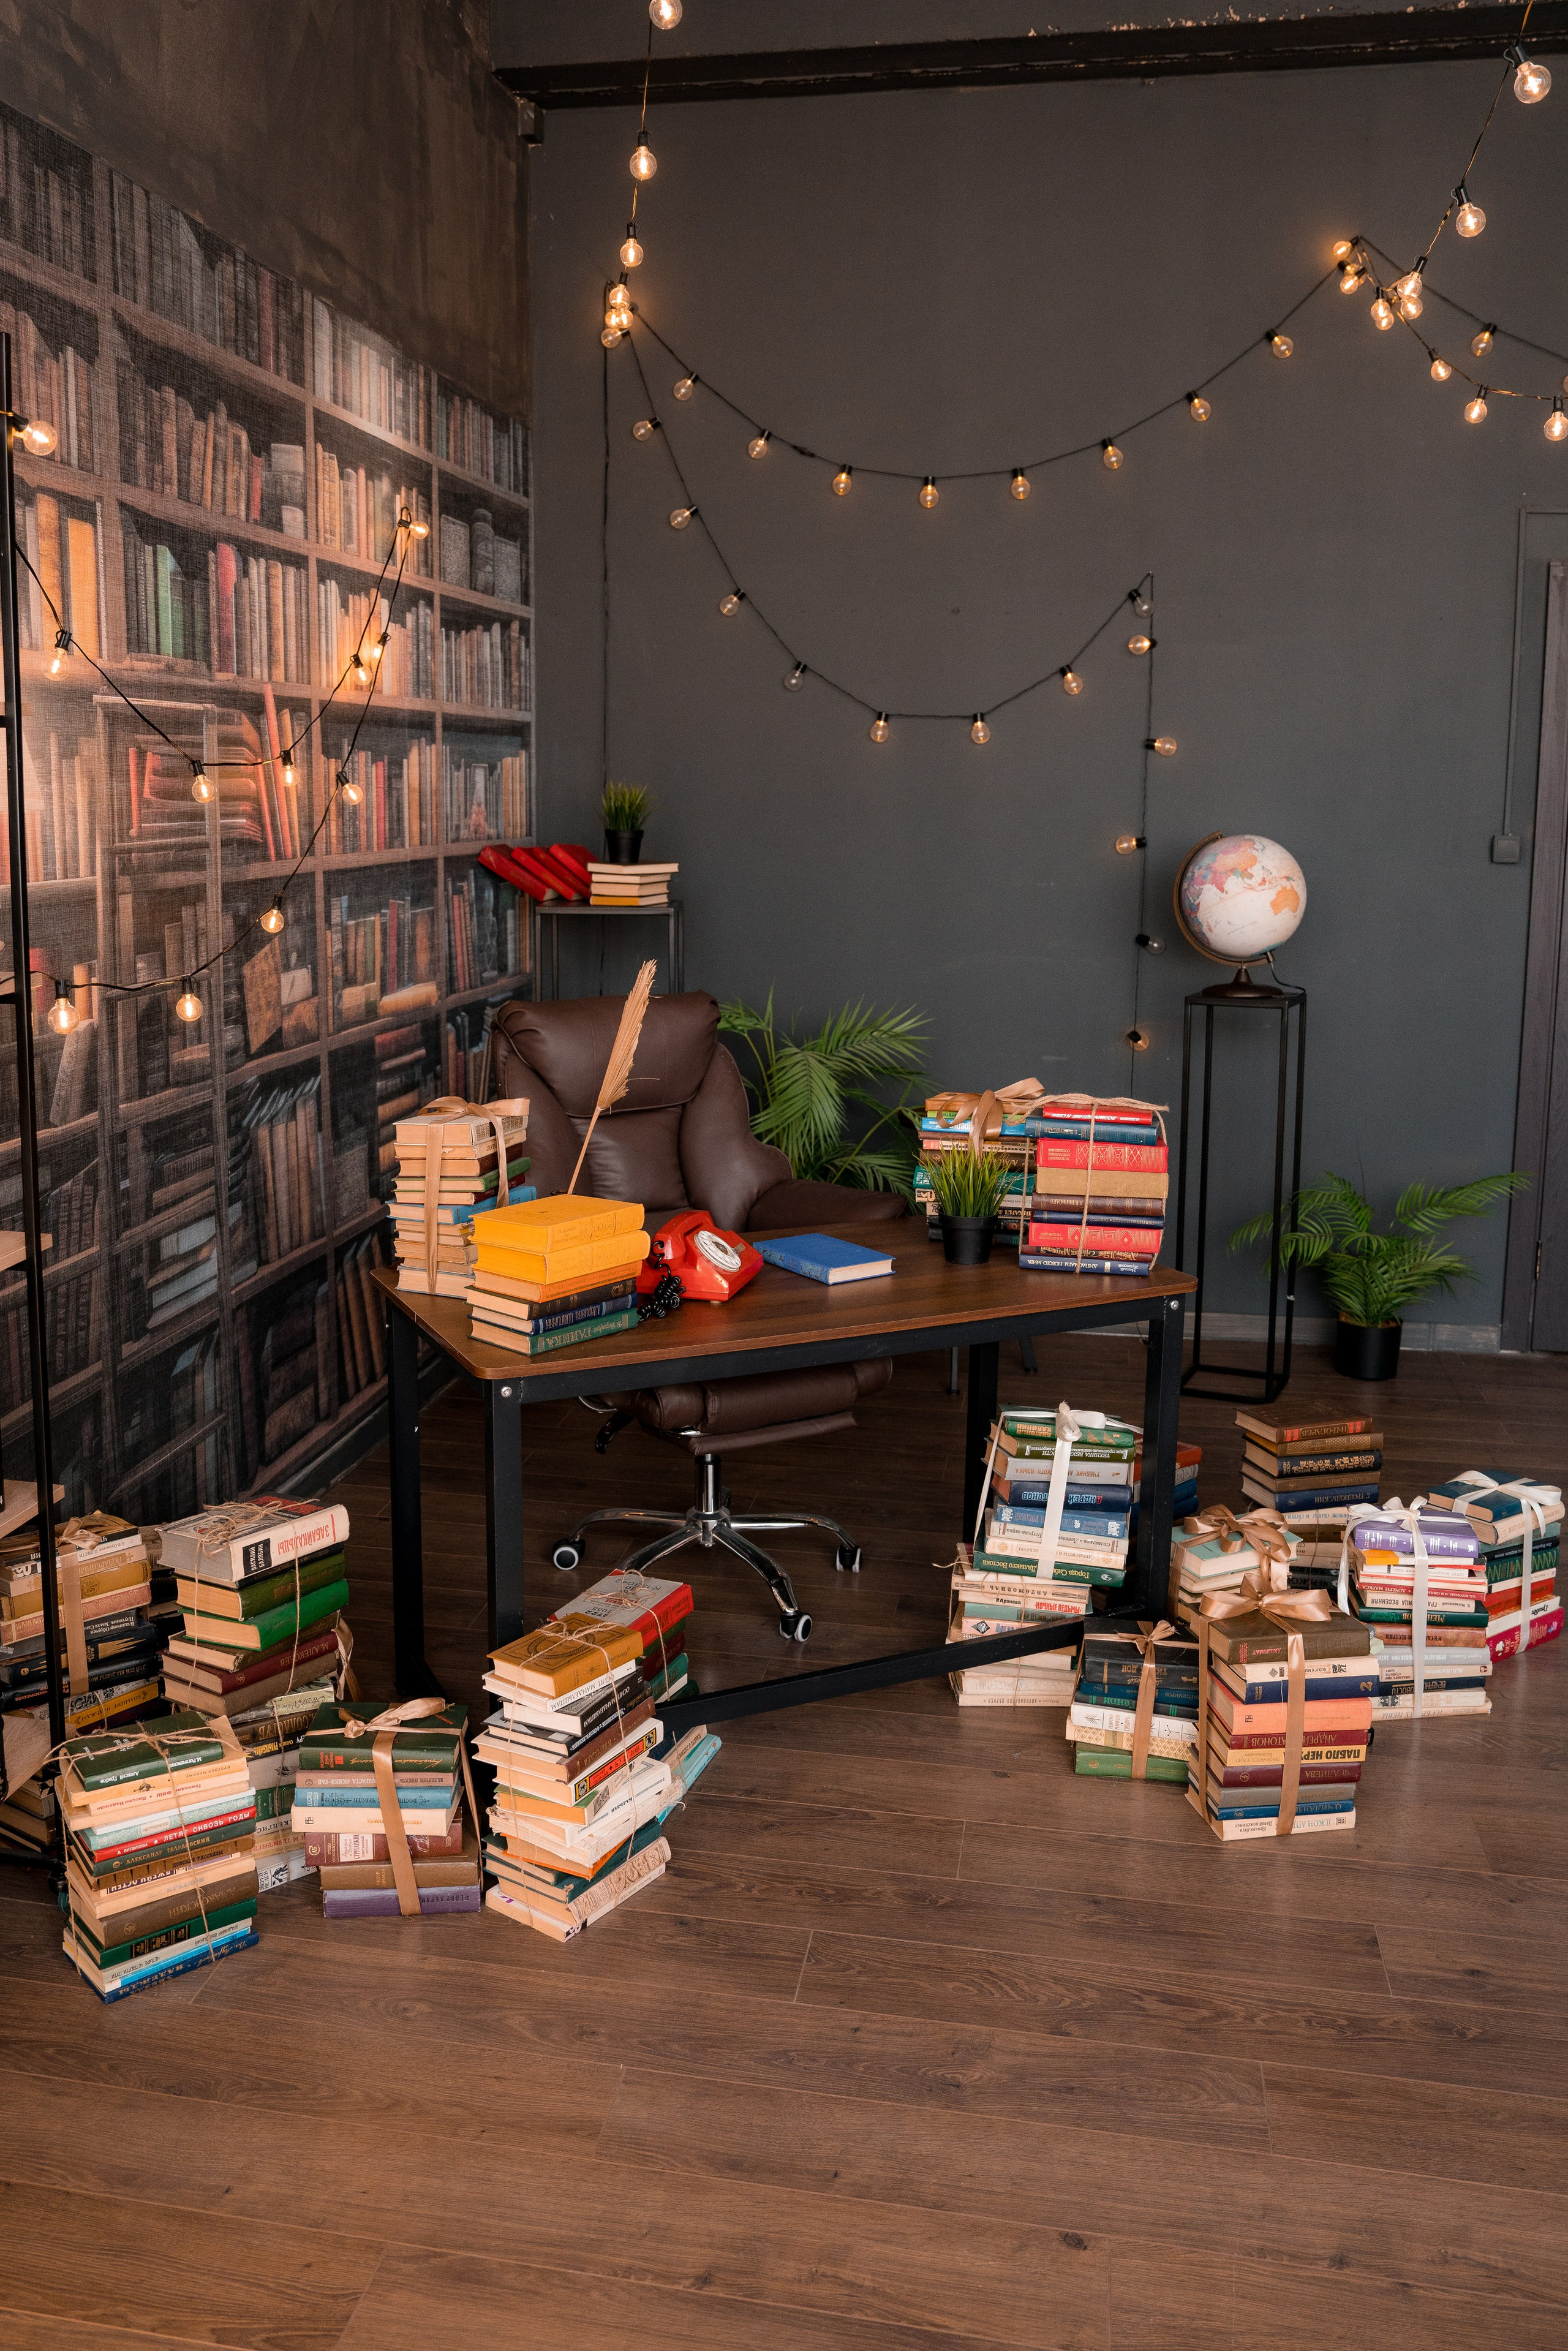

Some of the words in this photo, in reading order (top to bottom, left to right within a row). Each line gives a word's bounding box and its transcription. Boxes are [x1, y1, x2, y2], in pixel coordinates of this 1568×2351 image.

[546, 1327, 591, 1348] ГЛИНКА
[1327, 1476, 1364, 1485] АДАМОВИЧ
[1068, 1495, 1102, 1504] АНДРЕЙ
[1314, 1494, 1365, 1503] ТРОЕПОЛЬСКИЙ
[1006, 1528, 1042, 1538] Багрова-внука
[277, 1525, 330, 1555] ЗАБАЙКАЛЬЦЫ
[79, 1549, 98, 1558] ПОВЕСТИ
[982, 1560, 1008, 1570] Востока
[1009, 1563, 1037, 1572] Дальнего
[1068, 1569, 1090, 1579] Города
[989, 1585, 1047, 1596] АВТОМОБИЛЬ
[90, 1625, 110, 1635] Обручев
[110, 1621, 134, 1632] Владимир
[320, 1642, 328, 1650] М.
[280, 1647, 319, 1666] АЛЕКСЕЕВ
[598, 1674, 615, 1687] ОСИП
[1360, 1681, 1372, 1691] 2
[551, 1683, 595, 1710] МАНДЕЛЬШТАМ
[617, 1686, 630, 1700] ОСИП
[113, 1694, 141, 1710] БОЛЬШИЕ
[1102, 1697, 1136, 1708] Генри
[81, 1705, 111, 1721] НАДЕЖДЫ
[583, 1697, 616, 1727] МАНДЕЛЬШТАМ
[258, 1715, 309, 1741] СОЛЛОГУБ
[1302, 1733, 1336, 1745] АНДРЕЙ
[584, 1739, 611, 1767] В.ВЕРЕСАЕВ
[1325, 1749, 1360, 1760] ПАБЛО
[205, 1765, 231, 1773] ПРОСПЕР
[119, 1770, 140, 1780] Алексей
[176, 1783, 201, 1792] Геннадий
[97, 1800, 125, 1810] Надежде
[126, 1794, 146, 1805] Письмо
[1307, 1819, 1331, 1827] ДЖОН
[124, 1843, 148, 1853] ЛИТВИНОВА
[164, 1829, 188, 1841] ЛЕТЯТ
[193, 1819, 224, 1832] СКВОЗЬ
[228, 1811, 250, 1822] ГОДЫ
[126, 1849, 164, 1865] АЛЕКСАНДР
[167, 1836, 210, 1853] ТВАРДОВСКИЙ
[173, 1857, 195, 1868] ДОНСКИЕ
[197, 1850, 223, 1861] РАССКАЗЫ
[264, 1881, 268, 1890] НЕ
[168, 1890, 226, 1919] ЧАКОВСКИЙ
[217, 1924, 239, 1936] ВЛАДИМИР
[195, 1932, 217, 1946] ВЫСОЦКИЙ
[145, 1956, 160, 1966] ЧЕТЫРЕ
[123, 1962, 143, 1973] ЧЕТВЕРТИ
[118, 1964, 183, 1995] НАДЕЖДЫ
